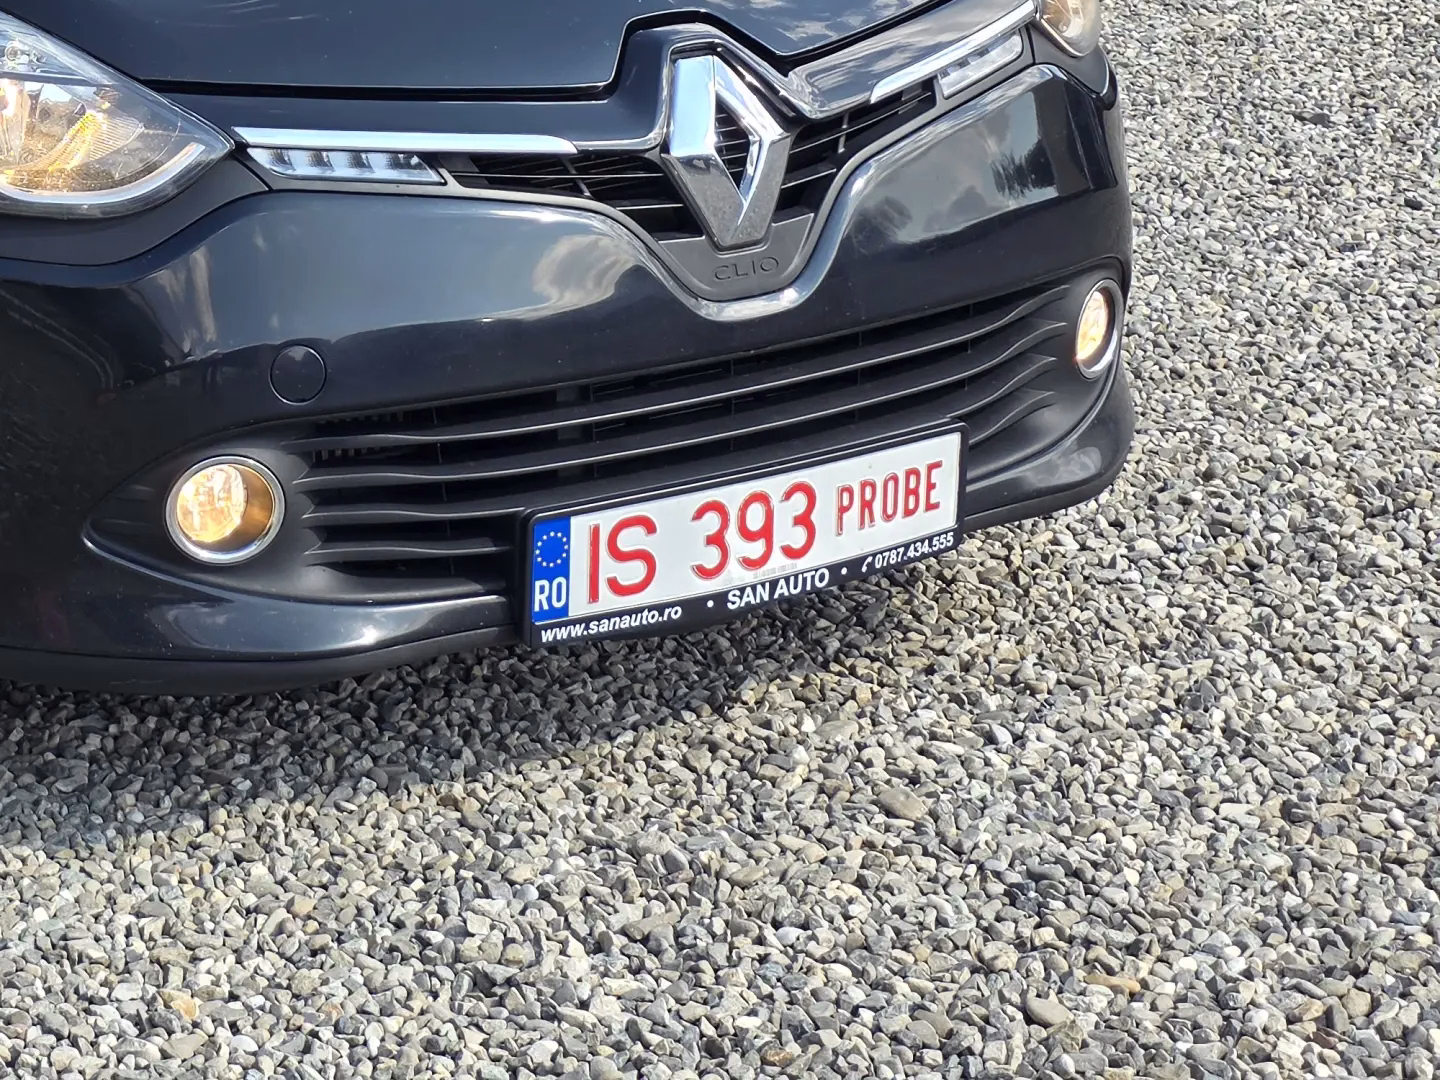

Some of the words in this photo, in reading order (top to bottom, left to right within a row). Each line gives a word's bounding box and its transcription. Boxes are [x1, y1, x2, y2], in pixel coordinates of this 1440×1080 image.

[714, 257, 779, 280] CLIO
[587, 514, 657, 605] IS
[690, 480, 817, 580] 393
[836, 459, 944, 537] PROBE
[534, 576, 567, 612] RO
[541, 606, 682, 643] www.sanauto.ro
[727, 583, 770, 610] SAN
[774, 568, 829, 598] AUTO
[874, 532, 954, 569] 0787.434.555
